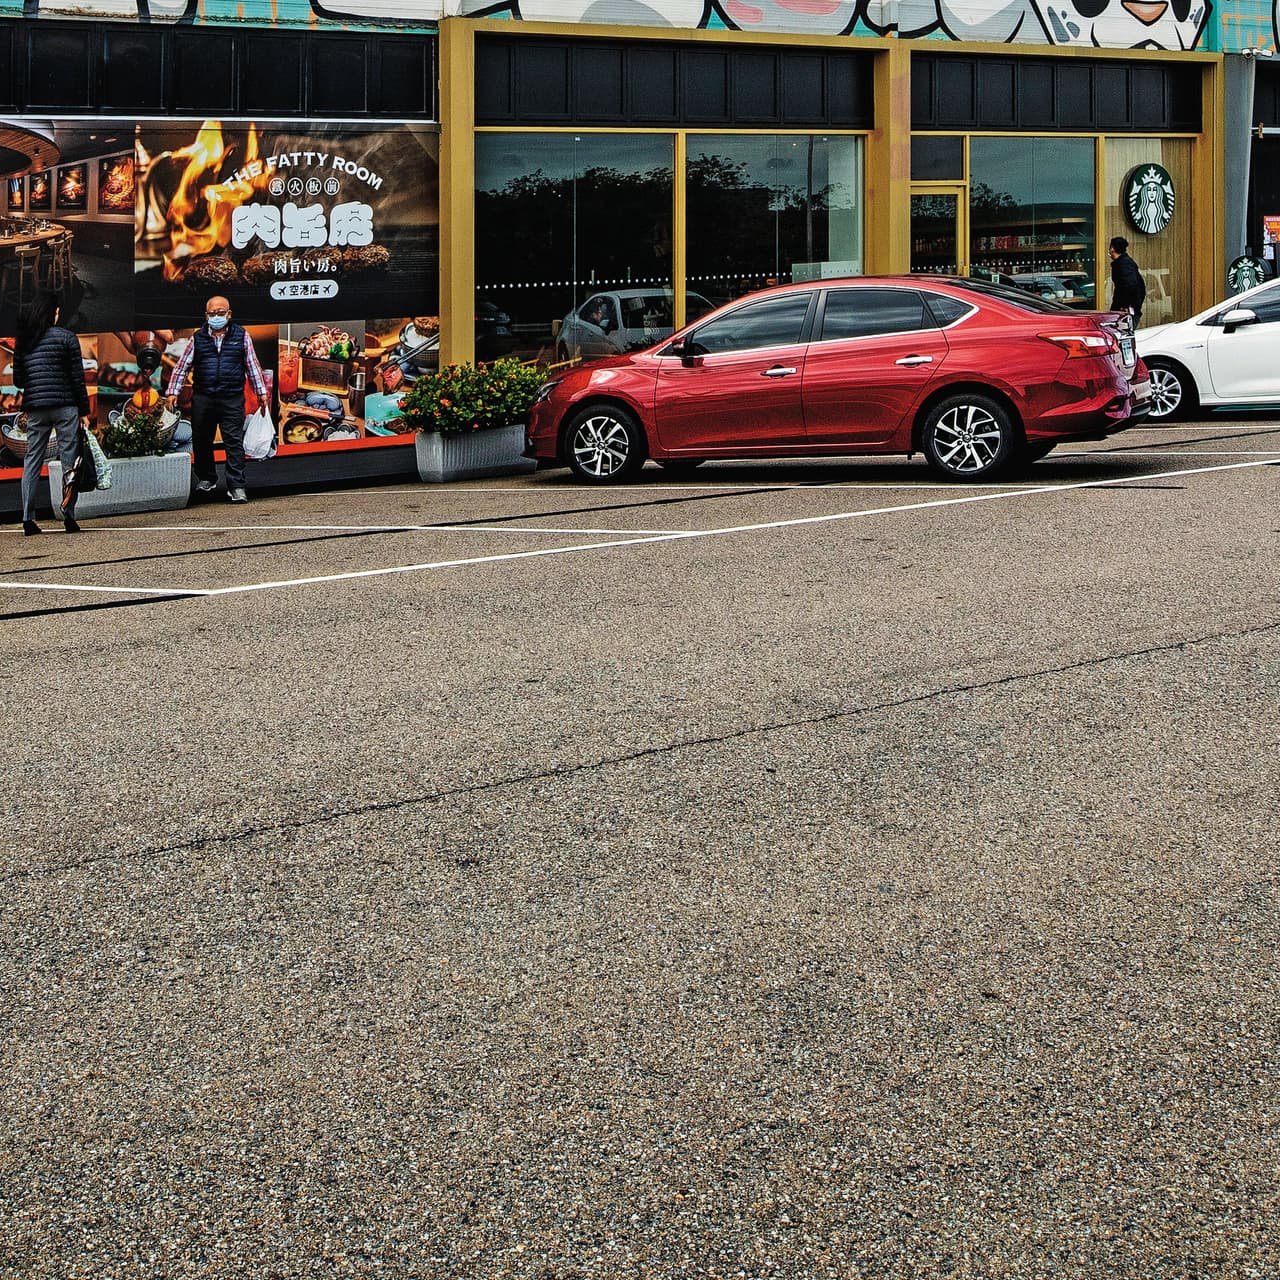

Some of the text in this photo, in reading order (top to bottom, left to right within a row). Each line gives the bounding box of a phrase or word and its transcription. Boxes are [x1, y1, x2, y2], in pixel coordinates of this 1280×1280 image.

[221, 151, 384, 191] THE FATTY ROOM
[289, 284, 320, 296] 空港店
